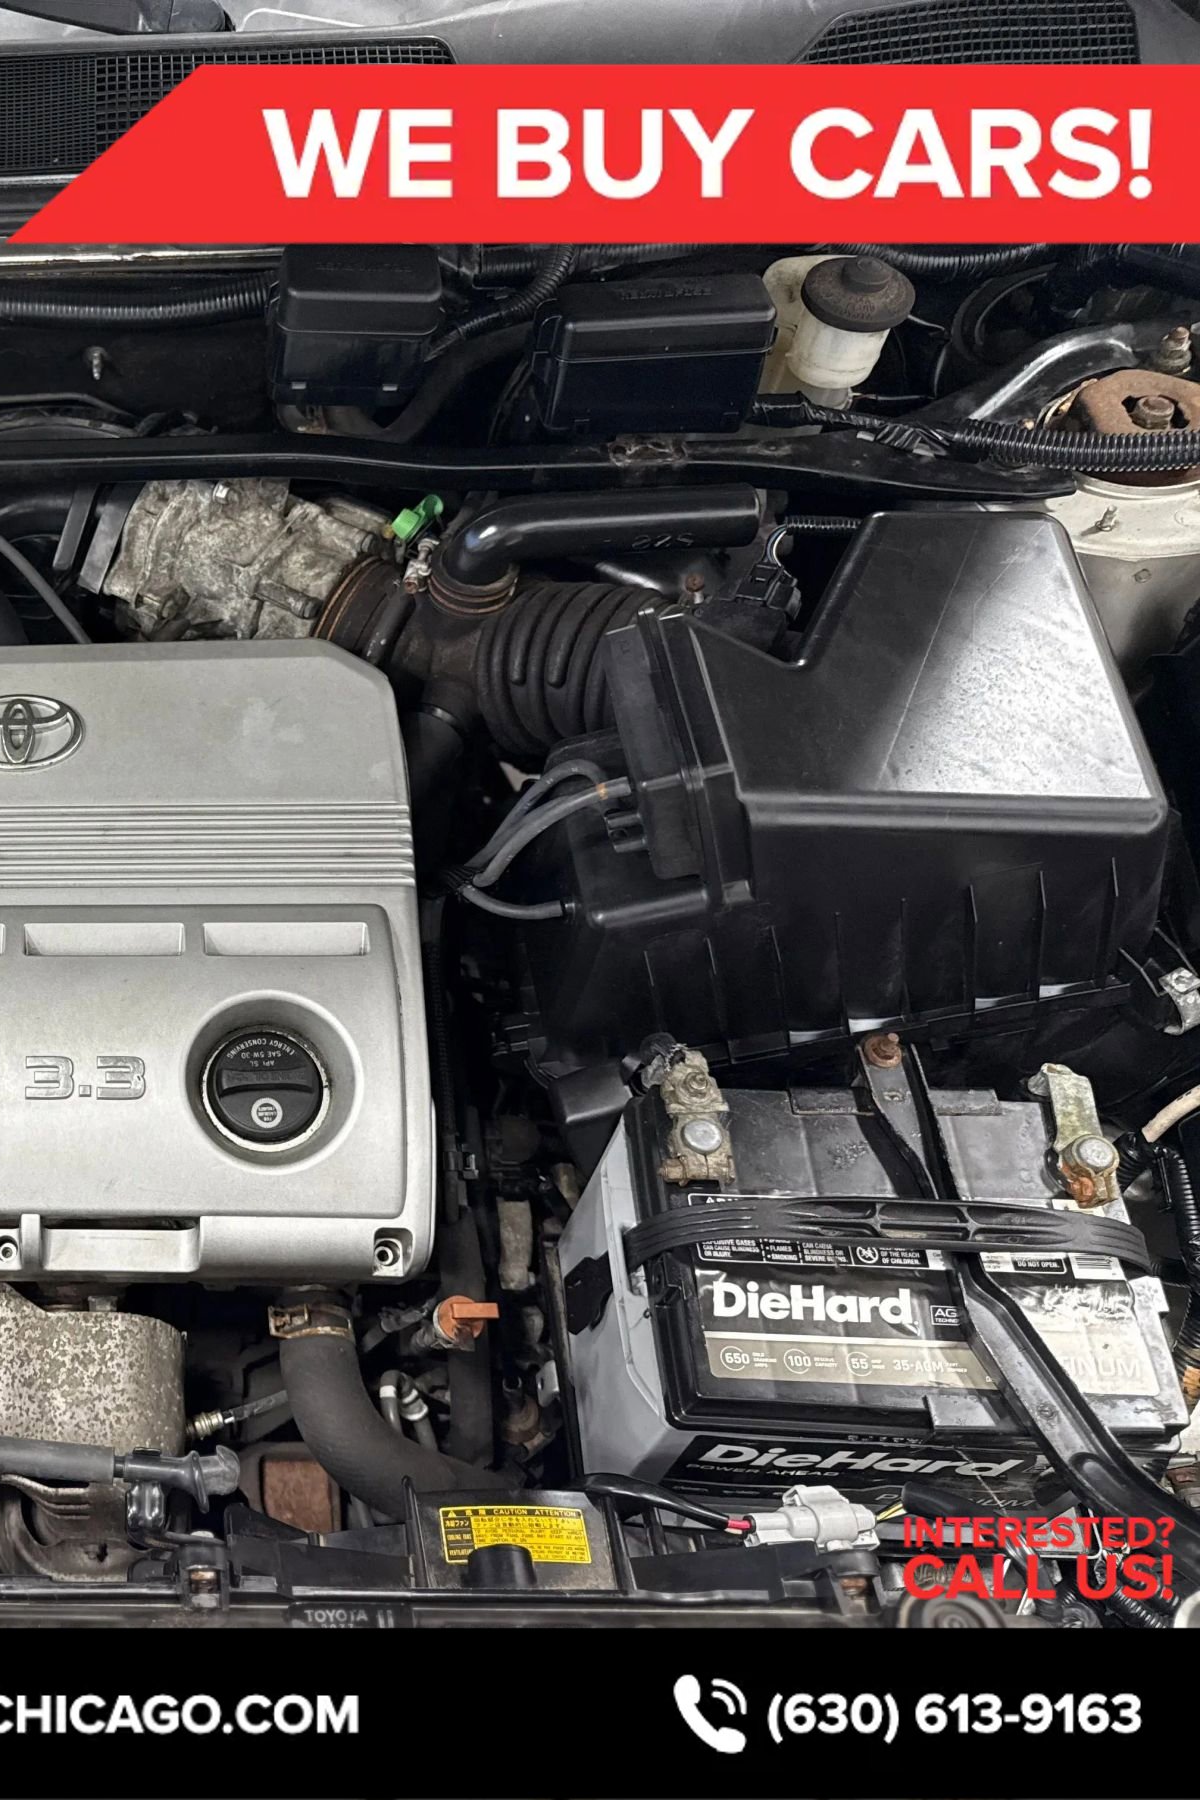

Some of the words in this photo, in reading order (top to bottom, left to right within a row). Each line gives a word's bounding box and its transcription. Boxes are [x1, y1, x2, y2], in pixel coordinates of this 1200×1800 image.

[226, 1038, 267, 1059] CONSERVING
[267, 1050, 282, 1058] SAE
[269, 1039, 295, 1056] ENERGY
[25, 1055, 146, 1100] 3.3
[712, 1280, 913, 1325] DieHard
[934, 1308, 957, 1318] AG
[724, 1352, 750, 1365] 650
[787, 1355, 812, 1368] 100
[698, 1444, 1024, 1477] DieHard
[685, 1463, 760, 1474] POWER
[765, 1469, 840, 1477] AHEAD
[304, 1609, 369, 1623] TOYOTA
